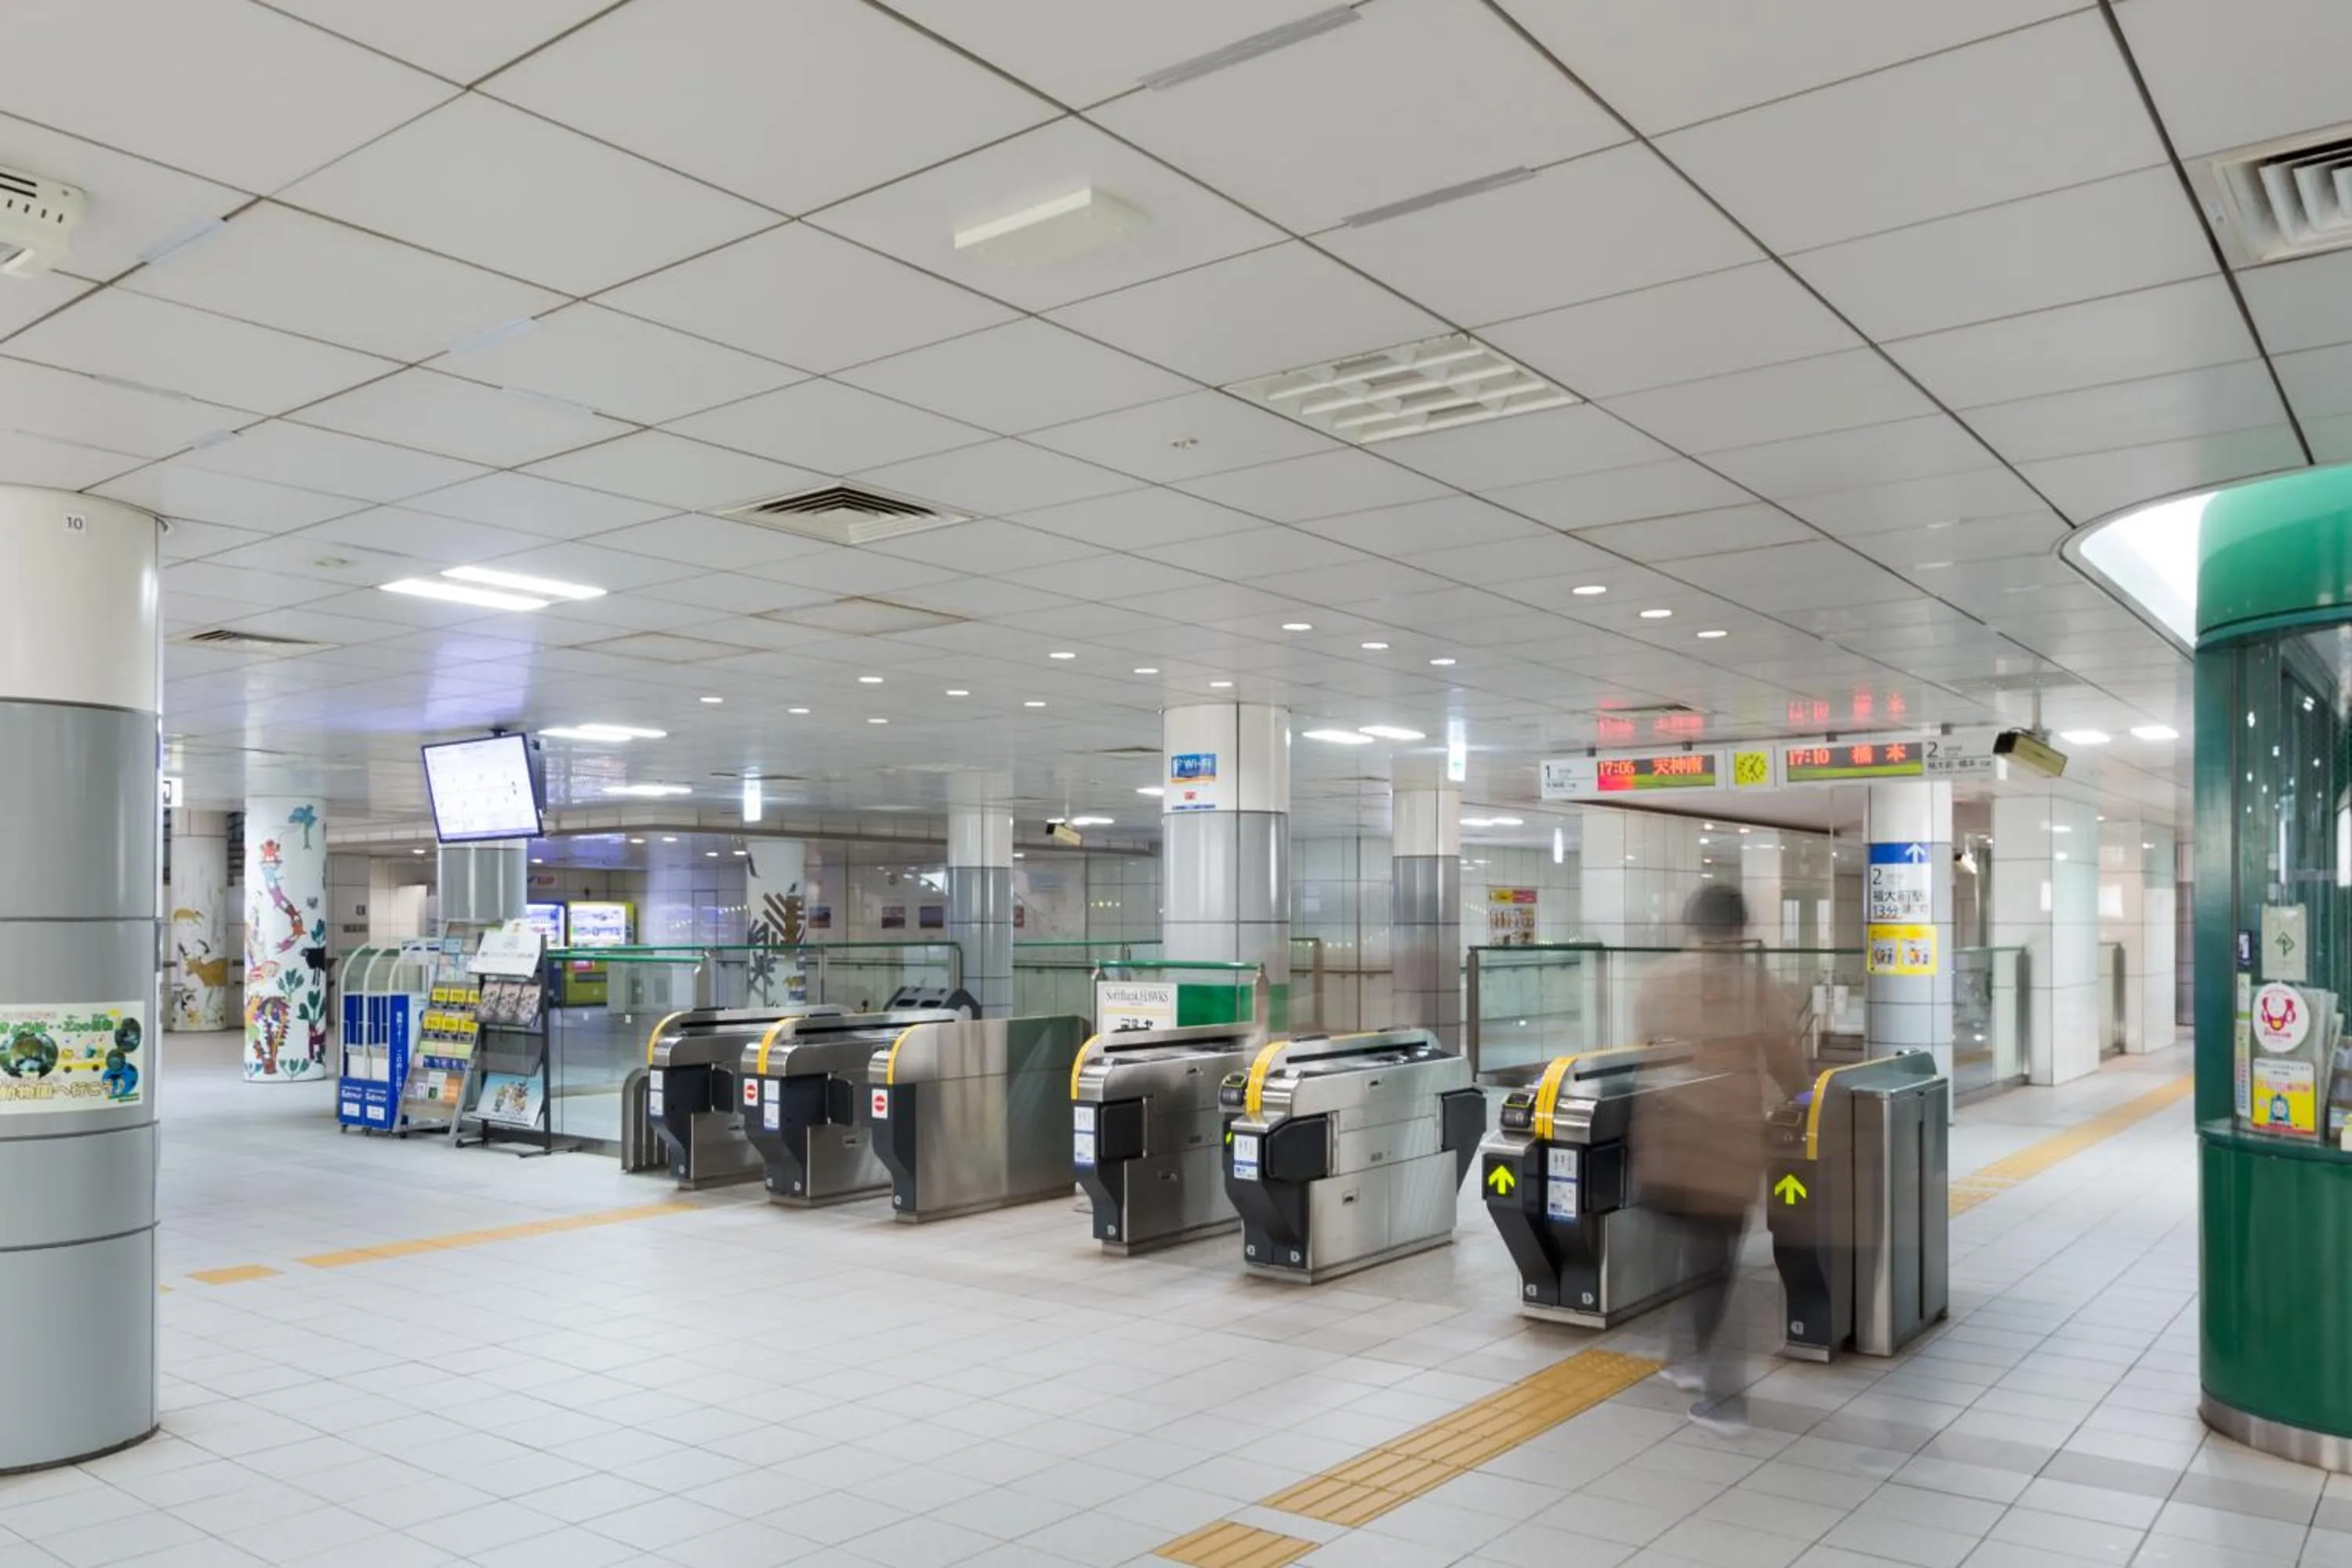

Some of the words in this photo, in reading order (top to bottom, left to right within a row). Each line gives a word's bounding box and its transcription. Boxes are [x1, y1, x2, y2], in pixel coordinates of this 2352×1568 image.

[67, 517, 83, 531] 10
[1926, 741, 1938, 758] 2
[1872, 868, 1882, 885] 2
